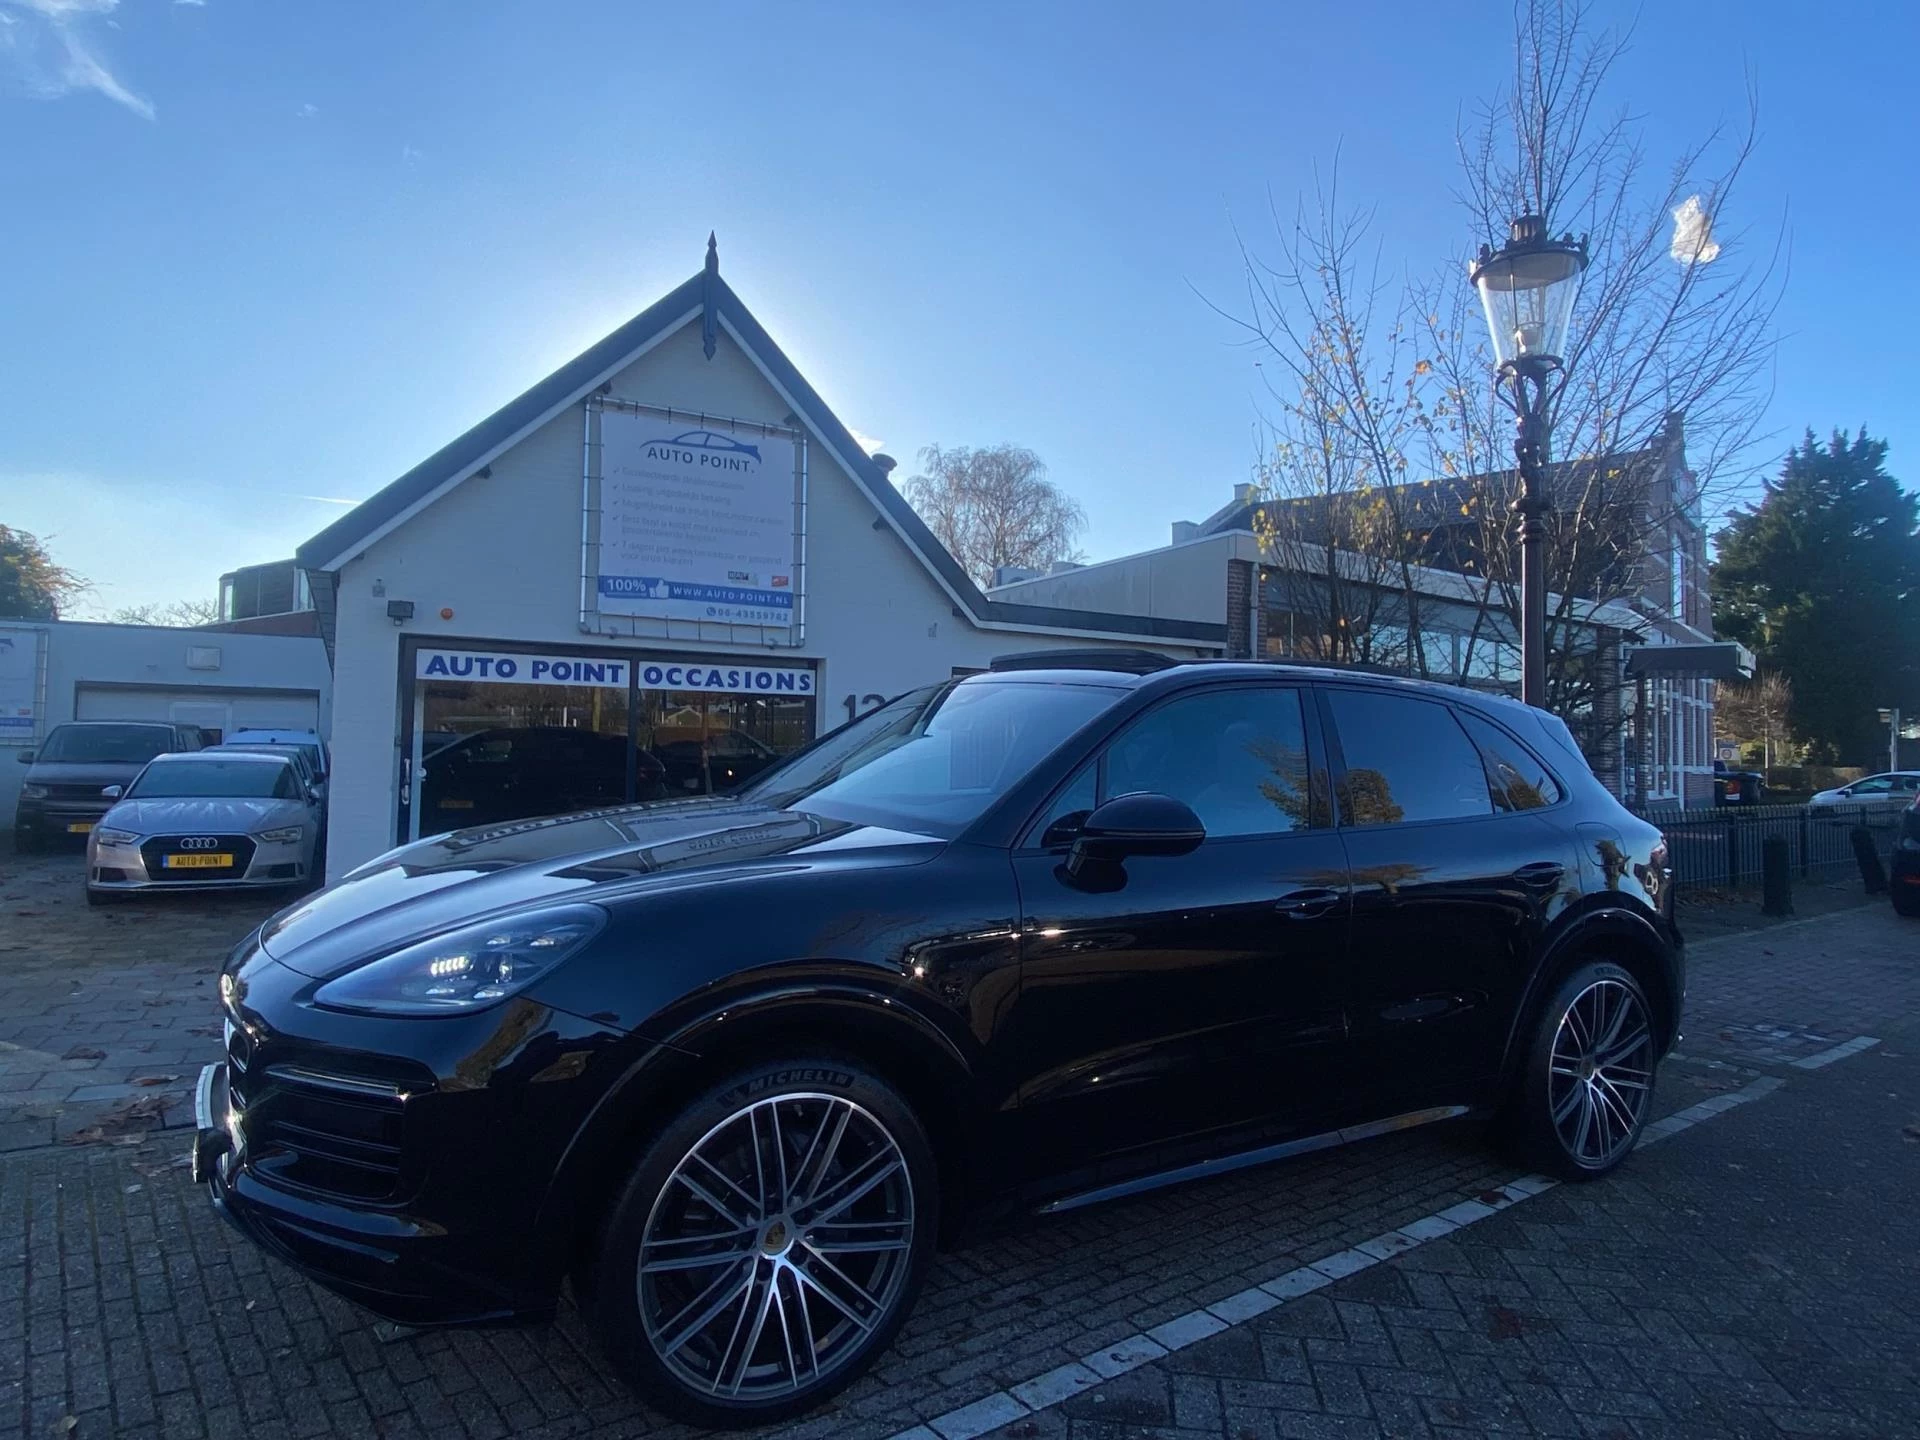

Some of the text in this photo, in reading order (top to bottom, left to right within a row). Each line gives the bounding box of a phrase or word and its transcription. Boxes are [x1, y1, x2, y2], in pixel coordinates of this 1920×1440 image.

[647, 447, 693, 464] AUTO
[607, 579, 646, 592] 100%
[425, 655, 625, 683] AUTO POINT
[643, 666, 811, 691] OCCASIONS
[750, 1069, 850, 1093] MICHELIN
